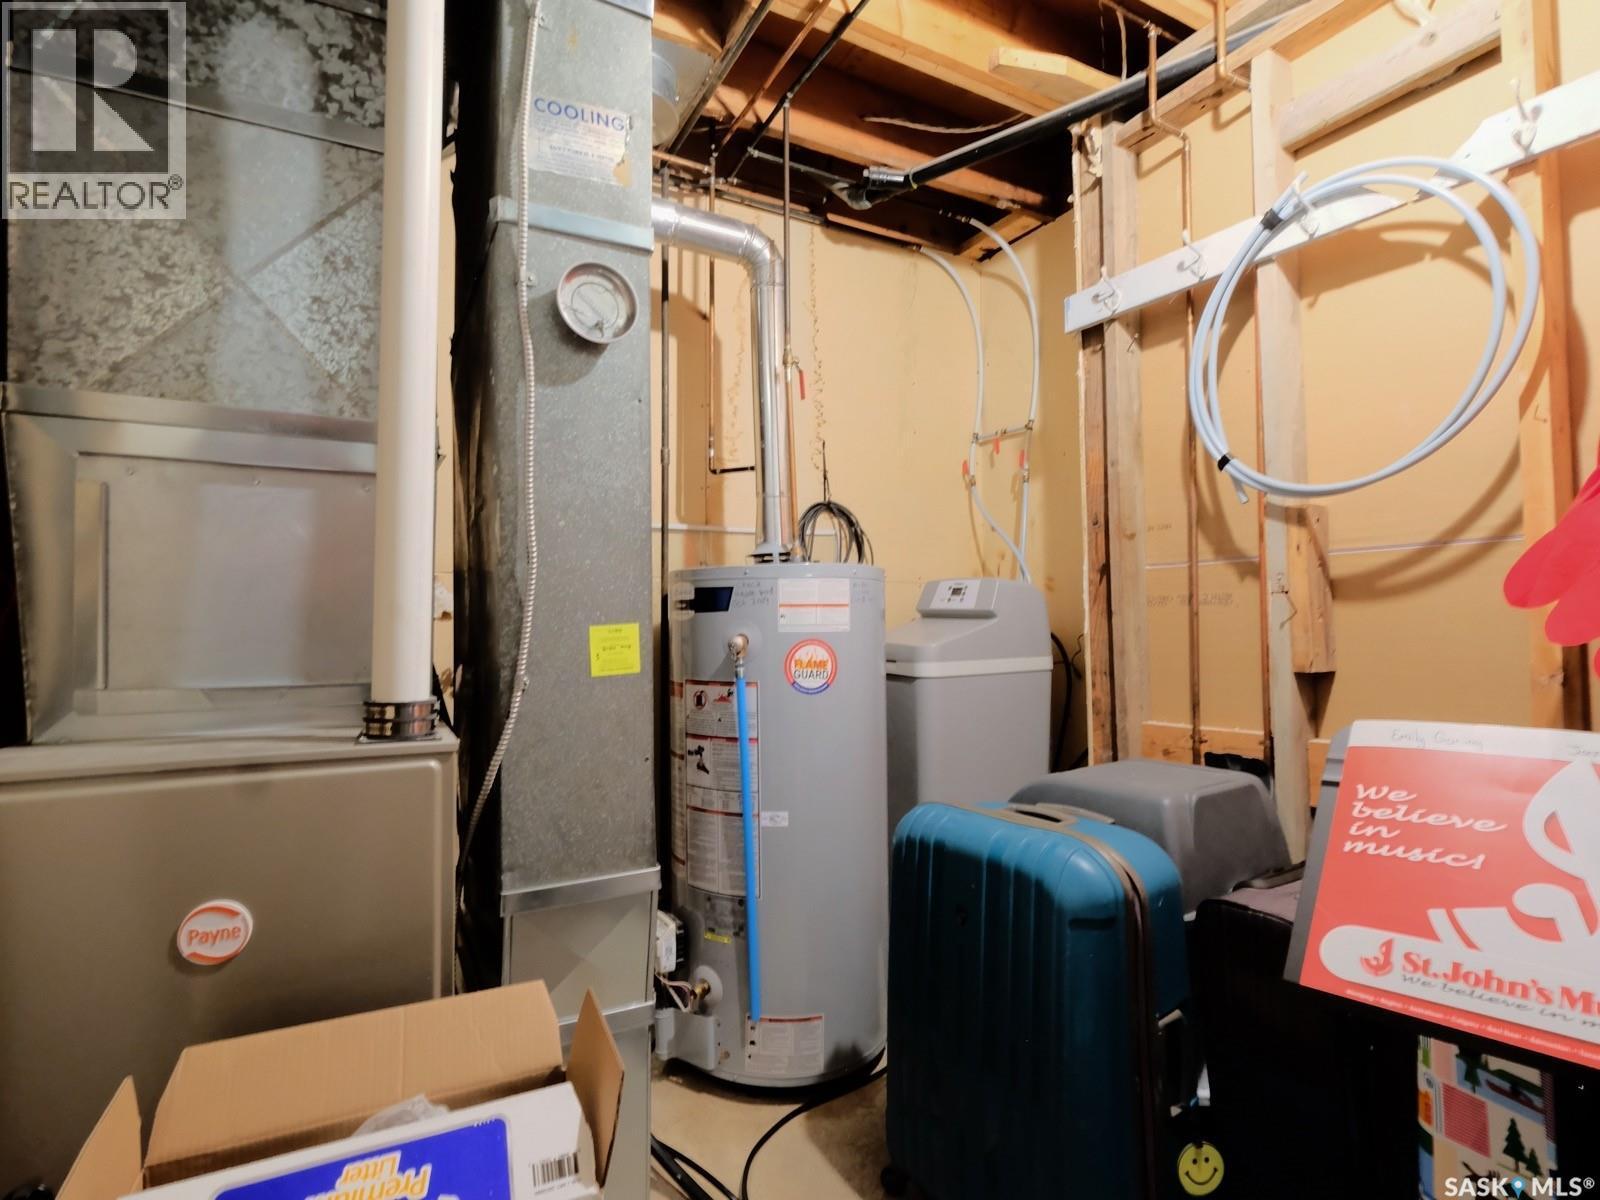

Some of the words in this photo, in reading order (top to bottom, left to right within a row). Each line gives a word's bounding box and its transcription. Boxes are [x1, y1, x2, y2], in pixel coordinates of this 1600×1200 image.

[534, 98, 625, 131] COOLING
[793, 669, 829, 680] GUARD
[794, 655, 828, 669] FLAME
[1348, 821, 1401, 838] in
[1351, 801, 1508, 832] believe
[1343, 840, 1485, 870] music!
[187, 926, 241, 947] Payne
[1442, 982, 1535, 1010] believe
[1538, 1007, 1574, 1021] in
[342, 1153, 398, 1185] Litter
